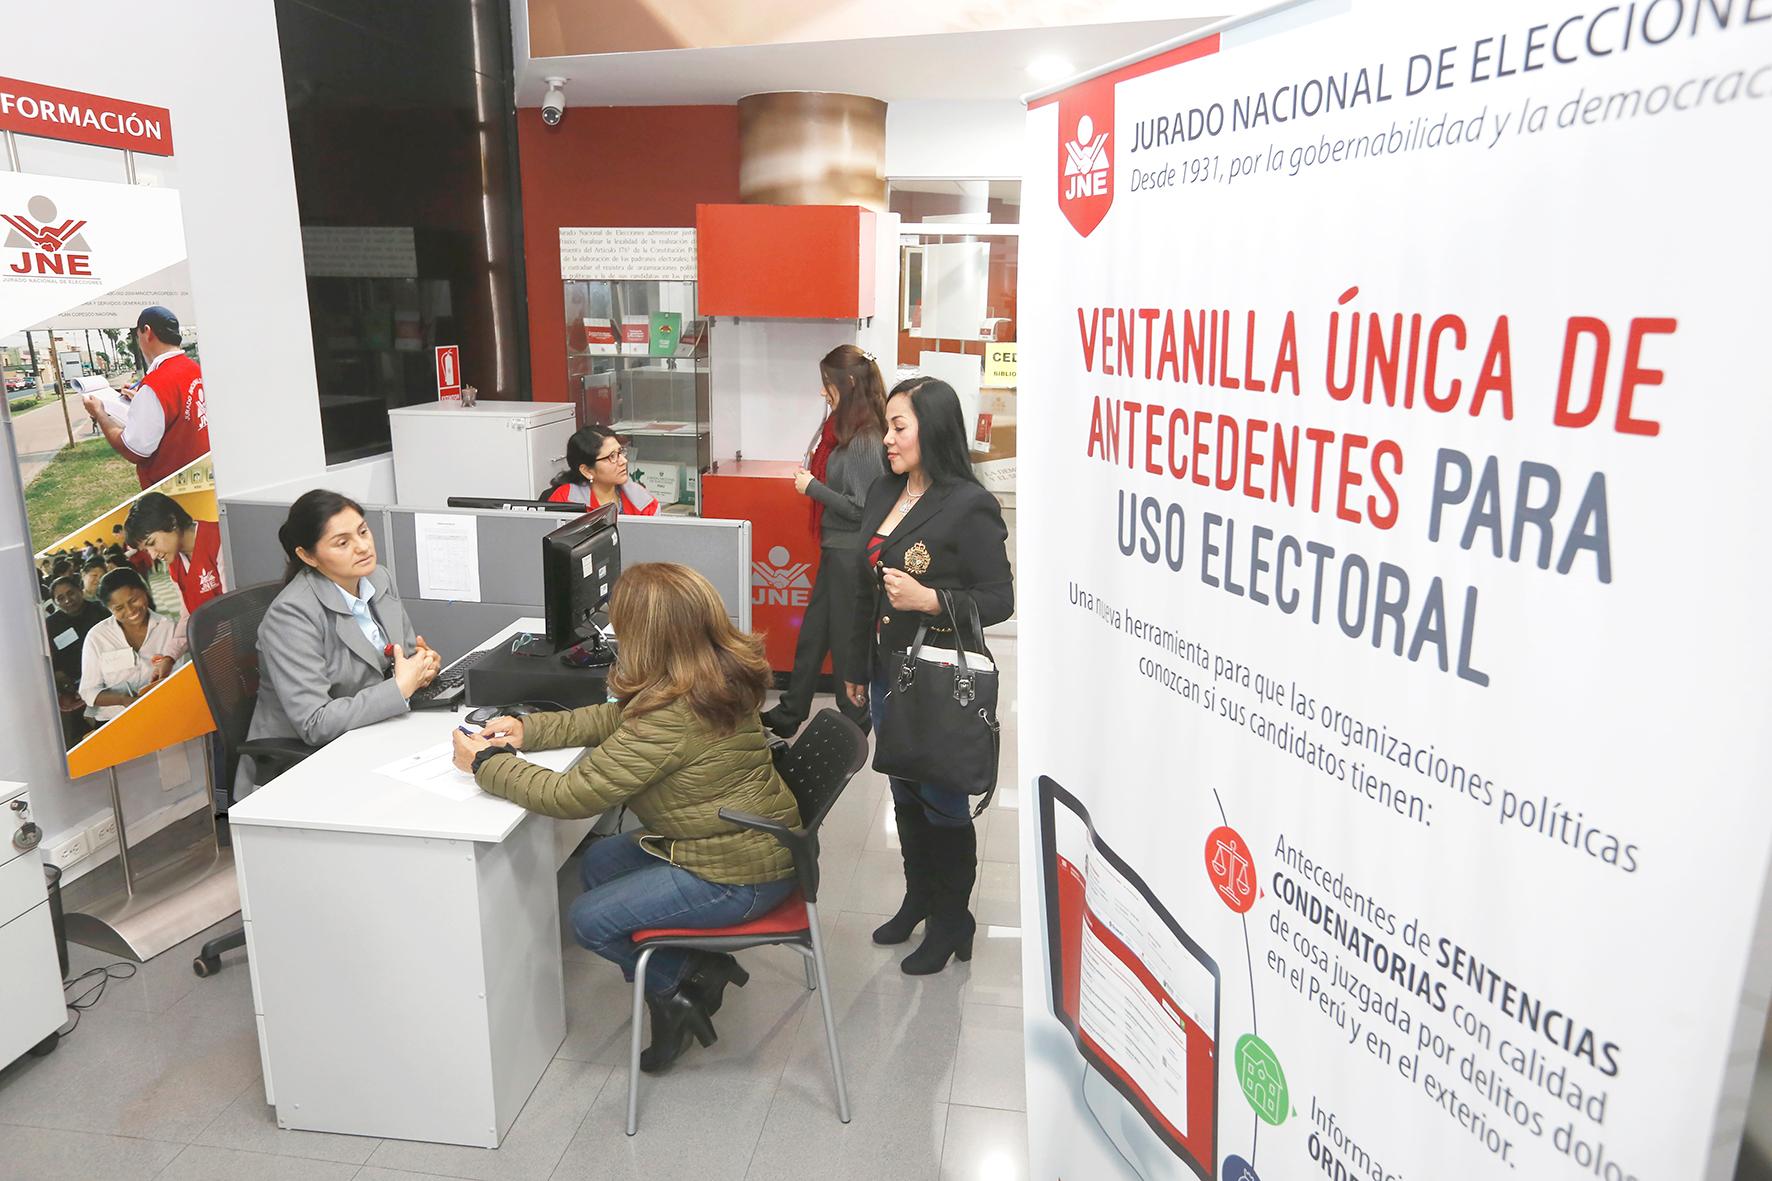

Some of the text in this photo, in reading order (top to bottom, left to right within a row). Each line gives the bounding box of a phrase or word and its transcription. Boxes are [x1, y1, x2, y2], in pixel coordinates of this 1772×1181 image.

[1130, 162, 1175, 192] Desde
[1182, 155, 1223, 185] 1931,
[1228, 152, 1263, 185] por
[1266, 143, 1283, 172] la
[1289, 105, 1488, 177] gobernabilidad
[1488, 112, 1511, 149] y
[1517, 97, 1549, 135] la
[1131, 103, 1224, 153] JURADO
[1233, 63, 1392, 132] NACIONAL
[1406, 45, 1457, 97] DE
[10, 251, 92, 276] JNE
[1065, 171, 1109, 201] JNE
[1077, 286, 1677, 437] VENTANILLA ÚNICA DE
[1087, 395, 1612, 585] ANTECEDENTES PARA
[752, 589, 810, 607] JNE
[1118, 489, 1490, 688] USO ELECTORAL
[1069, 581, 1639, 874] Una nueva herramienta para que las organizaciones políticas
[1139, 656, 1433, 827] conozcan si sus candidatos tienen:
[1272, 871, 1447, 1013] CONDENATORIAS
[1452, 1003, 1491, 1051] con
[1499, 1039, 1608, 1125] calidad
[1274, 833, 1620, 1078] Antecedentes de SENTENCIAS
[1267, 949, 1516, 1169] en el Perú y en el exterior.
[1269, 909, 1638, 1181] de cosa juzgada por delitos dolo
[1311, 1095, 1403, 1181] Informa
